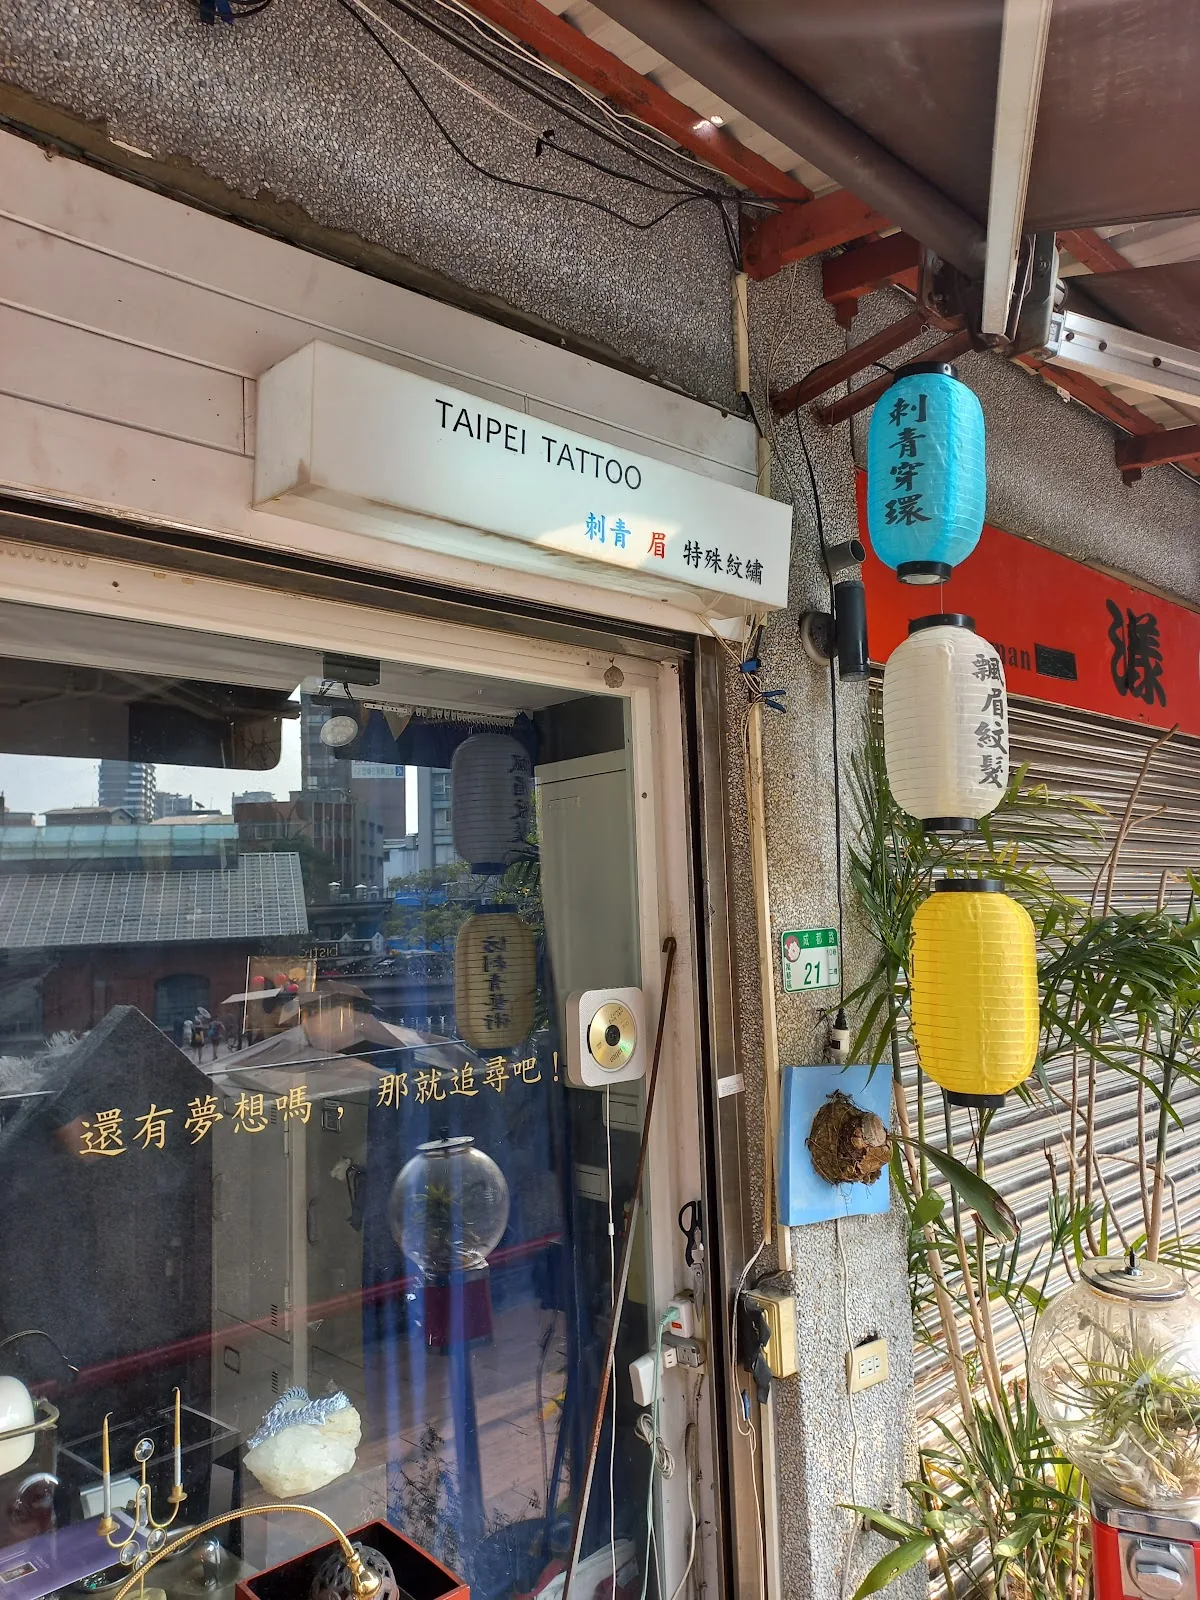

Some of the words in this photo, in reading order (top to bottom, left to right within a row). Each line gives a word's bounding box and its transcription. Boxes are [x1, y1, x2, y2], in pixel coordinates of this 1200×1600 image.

[435, 398, 526, 455] TAIPEI
[541, 435, 642, 490] TATTOO
[884, 394, 932, 526] 刺青穿環
[585, 511, 632, 549] 刺青
[647, 531, 666, 559] 眉
[683, 539, 764, 585] 特殊紋繡
[803, 961, 821, 985] 21
